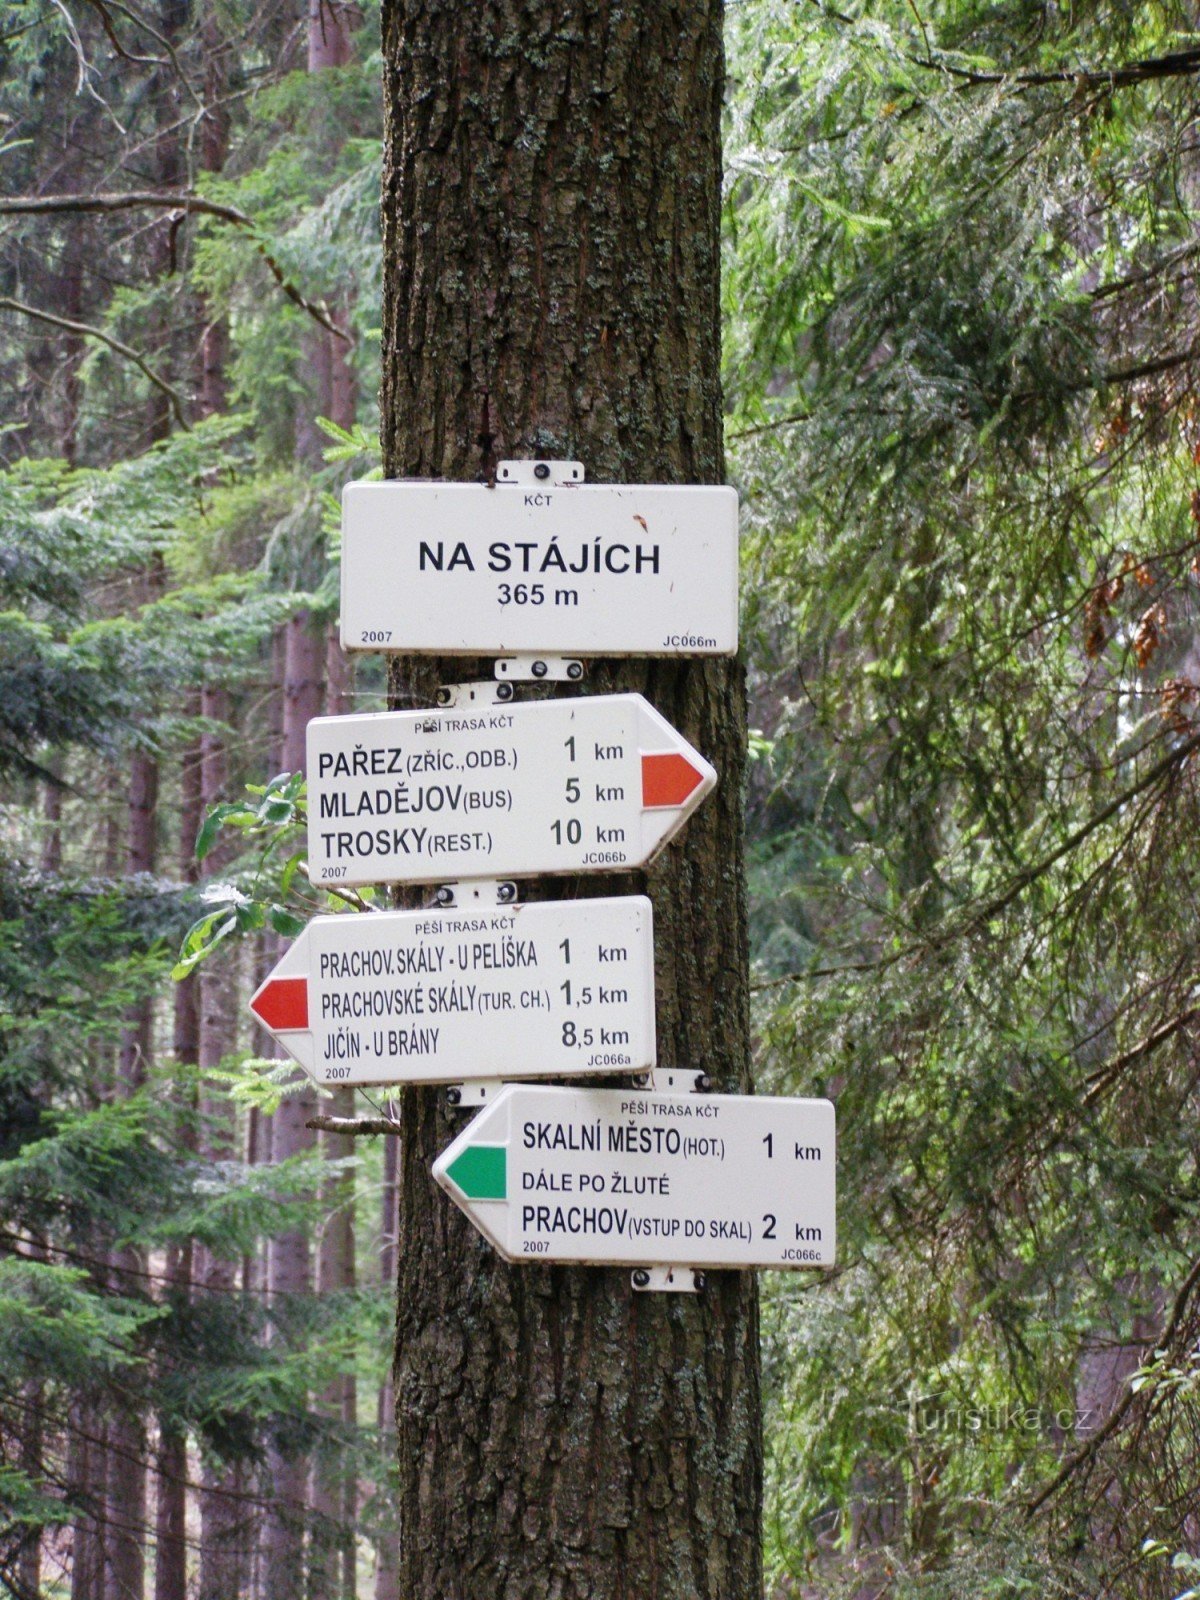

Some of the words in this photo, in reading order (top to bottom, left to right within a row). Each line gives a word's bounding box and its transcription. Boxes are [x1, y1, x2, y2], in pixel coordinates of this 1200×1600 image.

[524, 493, 552, 506] KČT
[419, 541, 475, 572] NA
[488, 535, 659, 574] STÁJÍCH
[497, 583, 545, 606] 365
[555, 589, 578, 606] m
[361, 631, 392, 642] 2007
[663, 636, 716, 647] JC066m
[445, 719, 486, 732] TRASA
[490, 715, 513, 728] KČT
[564, 736, 575, 762] 1
[595, 743, 623, 760] km
[565, 777, 580, 803] 5
[596, 784, 624, 802] km
[550, 818, 582, 845] 10
[596, 826, 625, 843] km
[582, 851, 626, 864] JC066b
[322, 867, 347, 878] 2007
[415, 920, 442, 935] PĚŠÍ
[446, 920, 487, 932] TRASA
[491, 916, 515, 930] KČT
[458, 948, 468, 970] U
[473, 935, 538, 970] PELÍŠKA
[559, 938, 570, 964] 1
[598, 945, 627, 962] km
[322, 982, 424, 1019] PRACHOVSKÉ
[520, 990, 550, 1012] CH.)
[560, 980, 592, 1008] 1,5
[599, 986, 627, 1004] km
[324, 1026, 360, 1060] JIČÍN
[374, 1034, 384, 1057] U
[388, 1023, 439, 1056] BRÁNY
[562, 1021, 593, 1049] 8,5
[600, 1028, 629, 1045] km
[588, 1054, 631, 1066] JC066a
[326, 1067, 351, 1079] 2007
[620, 1100, 648, 1115] PĚŠÍ
[651, 1103, 692, 1117] TRASA
[696, 1104, 719, 1118] KČT
[523, 1118, 602, 1152] SKALNÍ
[762, 1132, 773, 1159] 1
[795, 1142, 821, 1161] km
[522, 1168, 572, 1192] DÁLE
[579, 1174, 605, 1193] PO
[610, 1171, 670, 1195] ŽLUTÉ
[685, 1219, 705, 1238] DO
[710, 1220, 752, 1244] SKAL)
[762, 1213, 776, 1240] 2
[795, 1223, 822, 1241] km
[523, 1241, 550, 1253] 2007
[781, 1249, 821, 1261] JC066c
